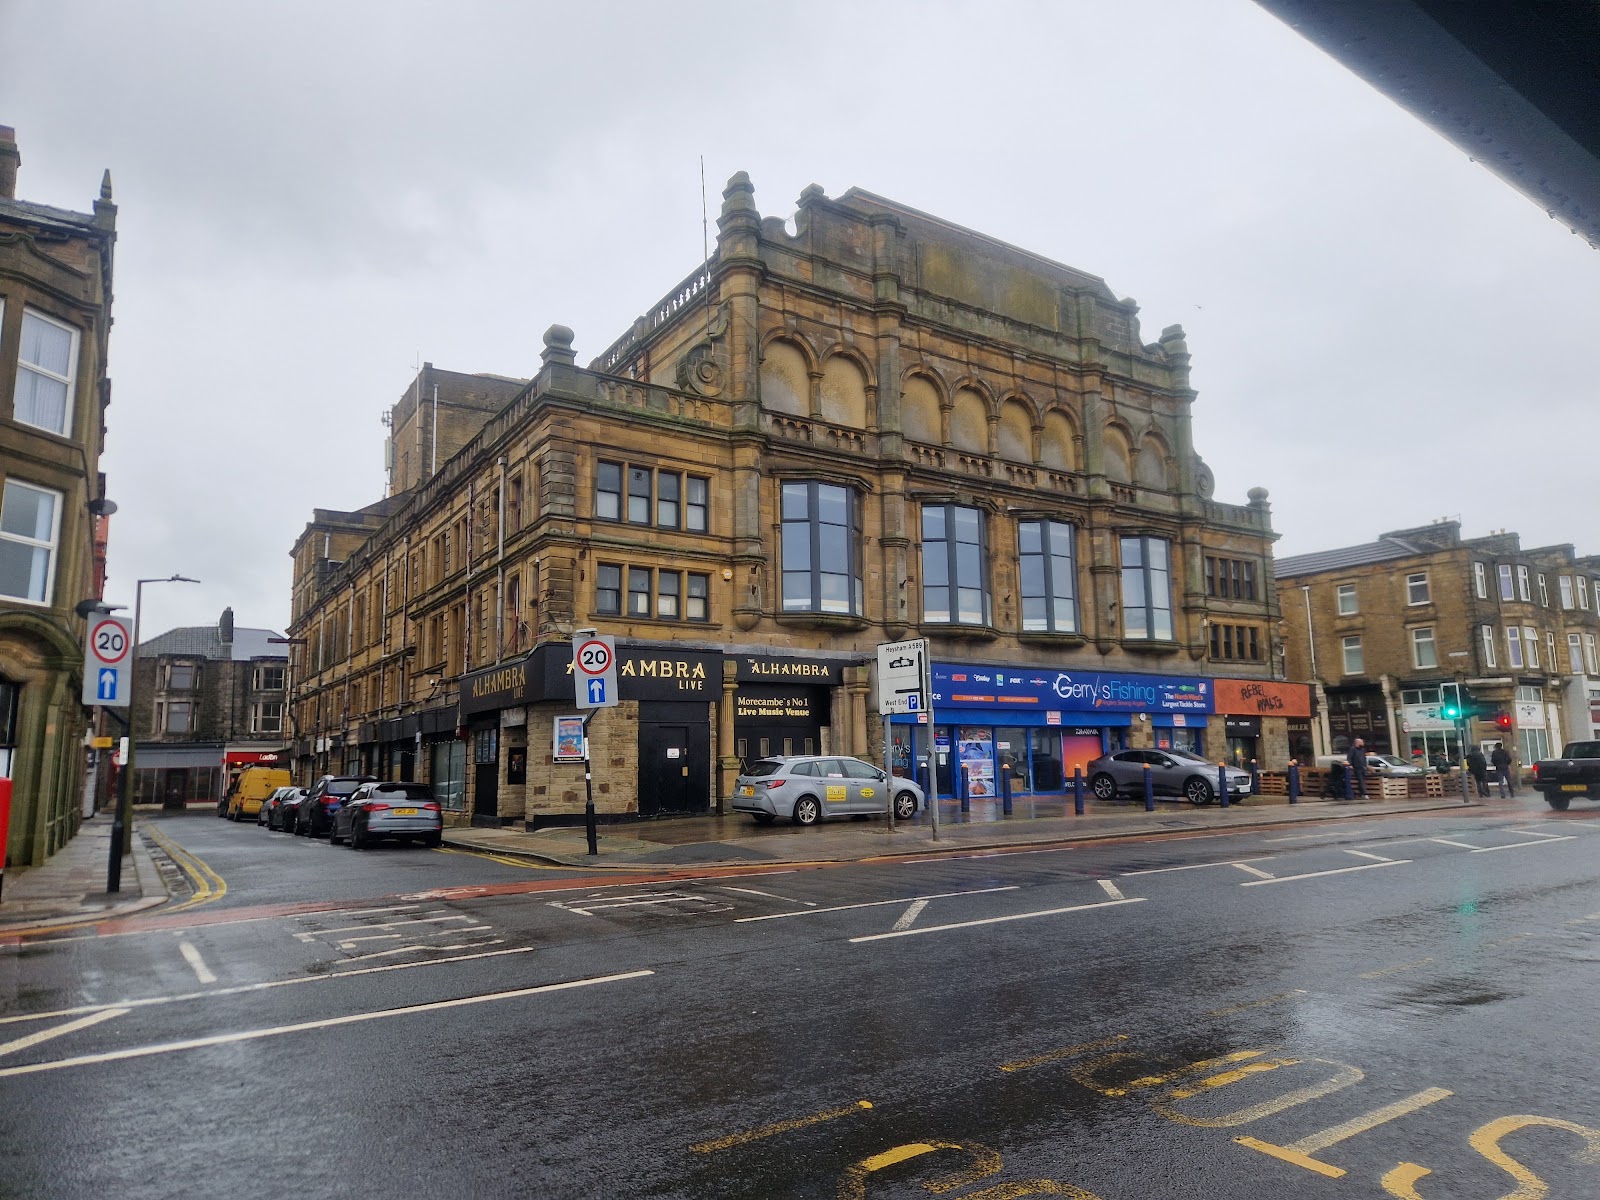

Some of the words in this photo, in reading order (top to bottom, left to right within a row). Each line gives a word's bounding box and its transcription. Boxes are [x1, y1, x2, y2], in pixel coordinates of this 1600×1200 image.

[98, 632, 124, 652] 20
[885, 646, 907, 654] Heysham
[583, 650, 607, 665] 20
[751, 662, 830, 677] ALHAMBRA
[472, 664, 526, 698] ALHAMBRA
[678, 680, 703, 691] LIVE
[513, 686, 524, 699] LIVE
[1164, 692, 1174, 700] The
[1240, 684, 1266, 700] REBEL
[1162, 700, 1179, 709] Largest
[738, 708, 757, 716] Live
[758, 708, 784, 717] Music
[785, 708, 810, 717] Venue
